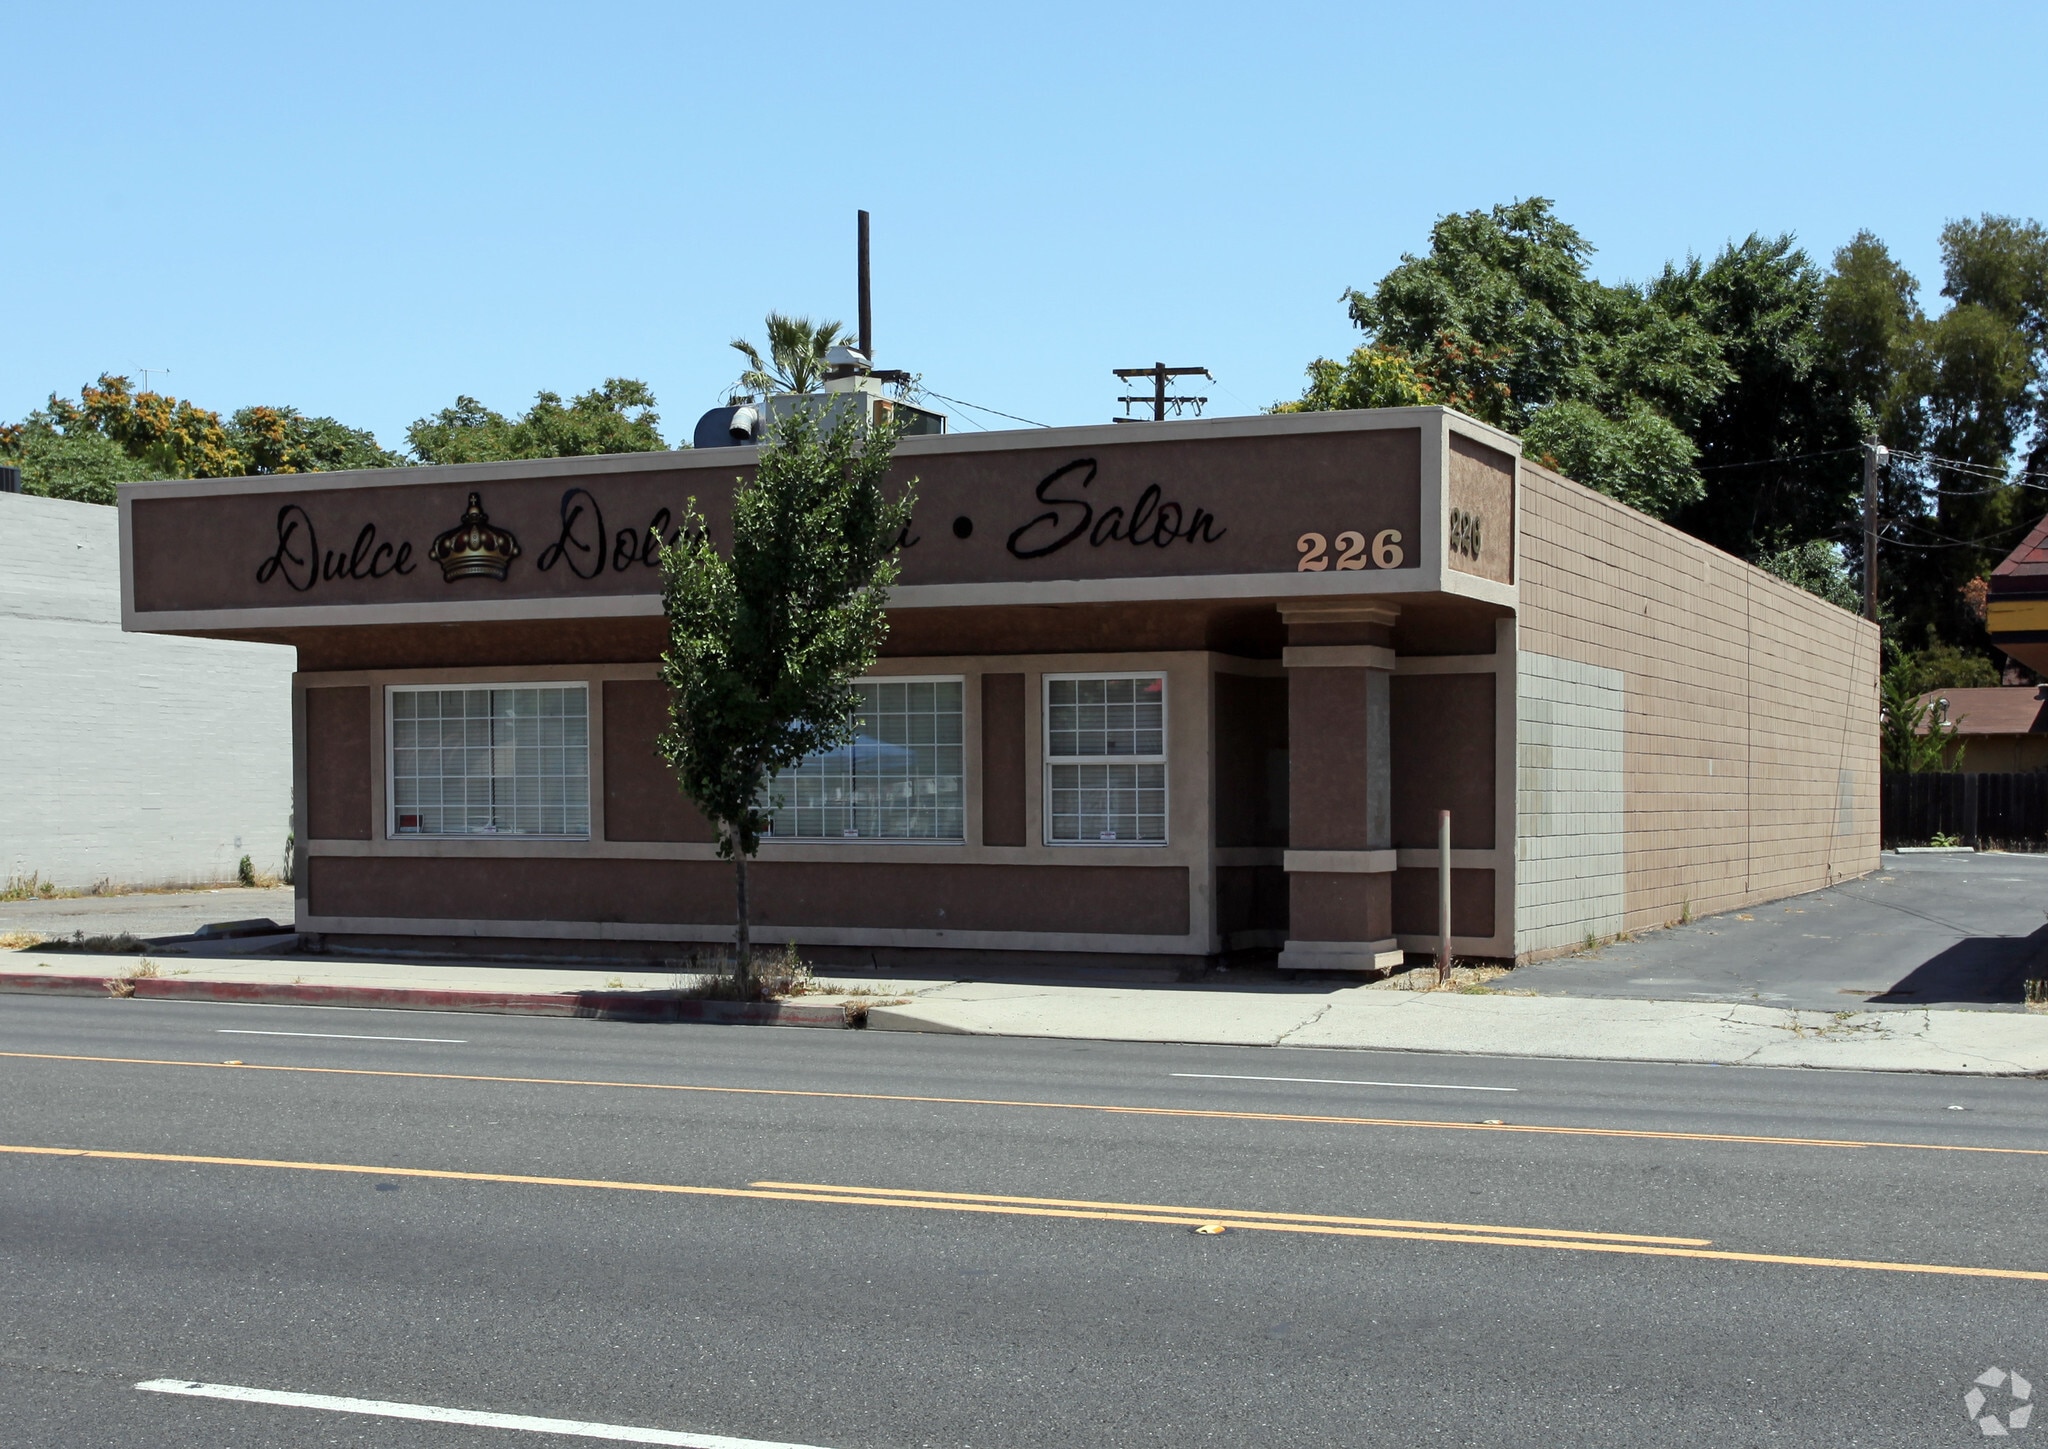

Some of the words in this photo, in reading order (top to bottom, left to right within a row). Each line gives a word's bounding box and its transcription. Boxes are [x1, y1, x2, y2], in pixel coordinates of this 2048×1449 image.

[257, 504, 417, 591] Dulce
[1006, 457, 1226, 560] Salon
[1450, 507, 1481, 558] 226
[1296, 529, 1404, 572] 226
